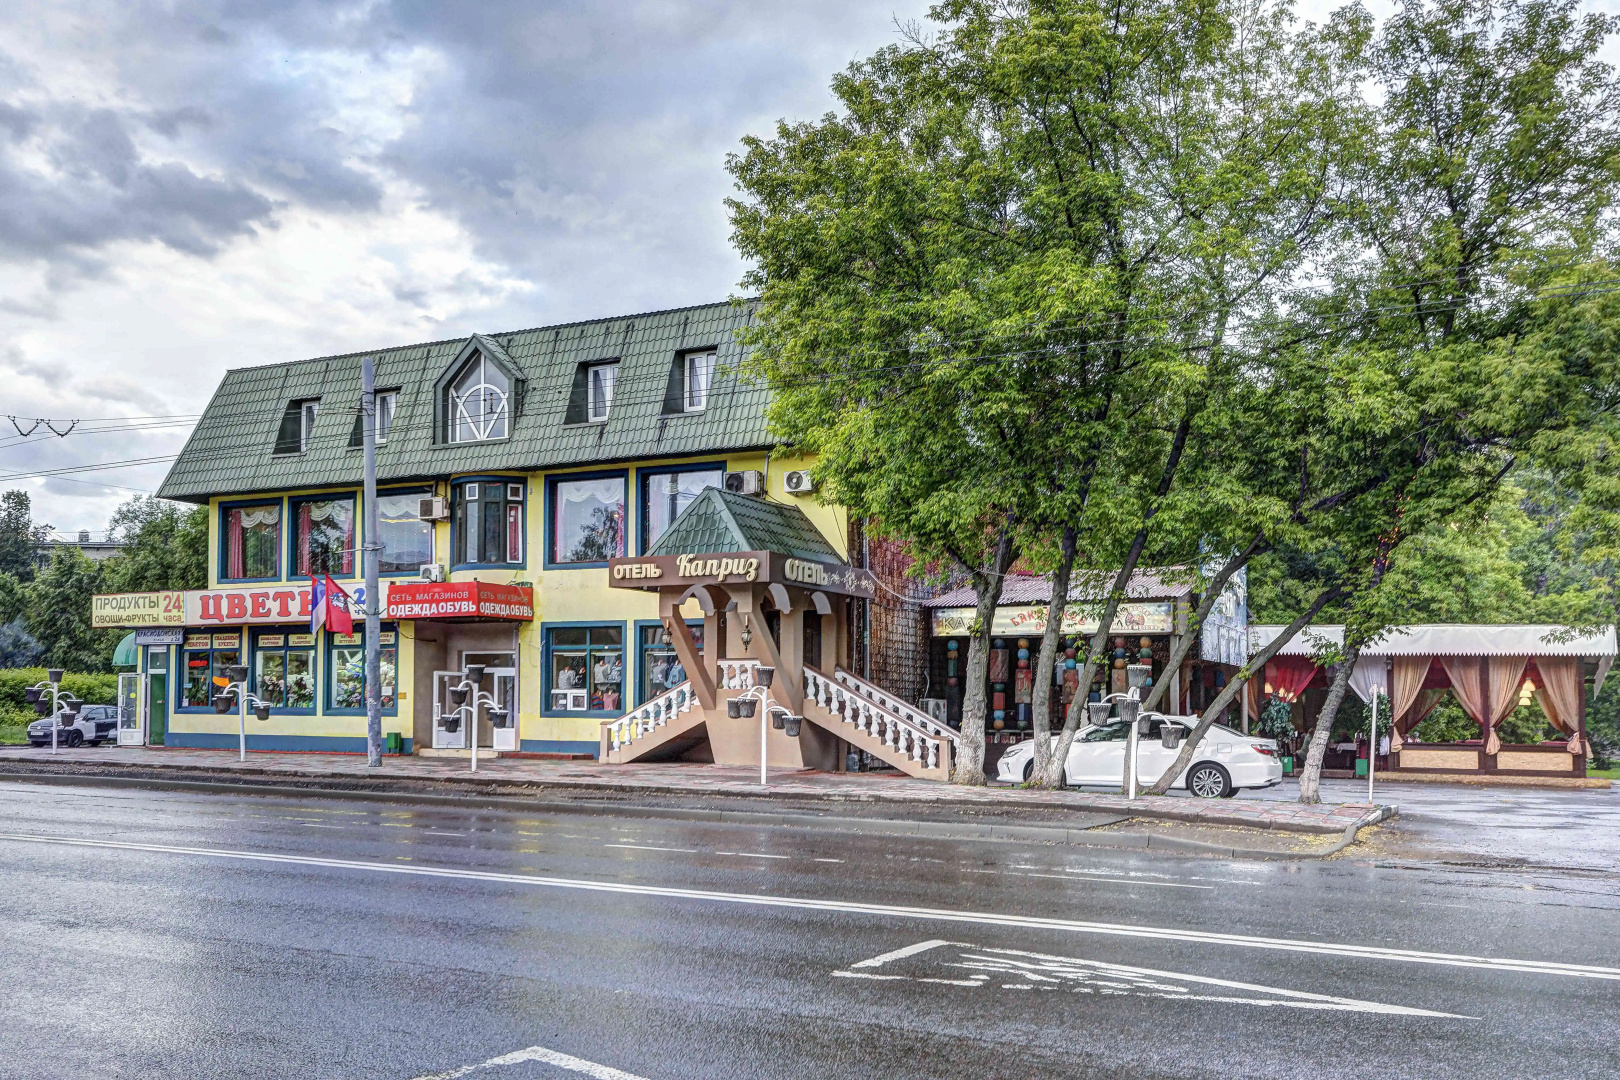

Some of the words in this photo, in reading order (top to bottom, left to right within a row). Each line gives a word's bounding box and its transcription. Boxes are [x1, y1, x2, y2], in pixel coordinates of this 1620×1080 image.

[613, 563, 663, 580] ОТЕЛЬ
[676, 553, 759, 582] Каприз
[785, 558, 829, 586] ОТЕЛЬ
[390, 593, 412, 601] СЕТЬ
[415, 591, 469, 600] МАГАЗИНОВ
[480, 591, 494, 600] СЕТЬ
[95, 596, 160, 612] ПРОДУКТЫ
[163, 594, 182, 613] 24
[94, 613, 160, 625] ОВОЩИ-ФРУКТЫ
[163, 614, 182, 623] часа
